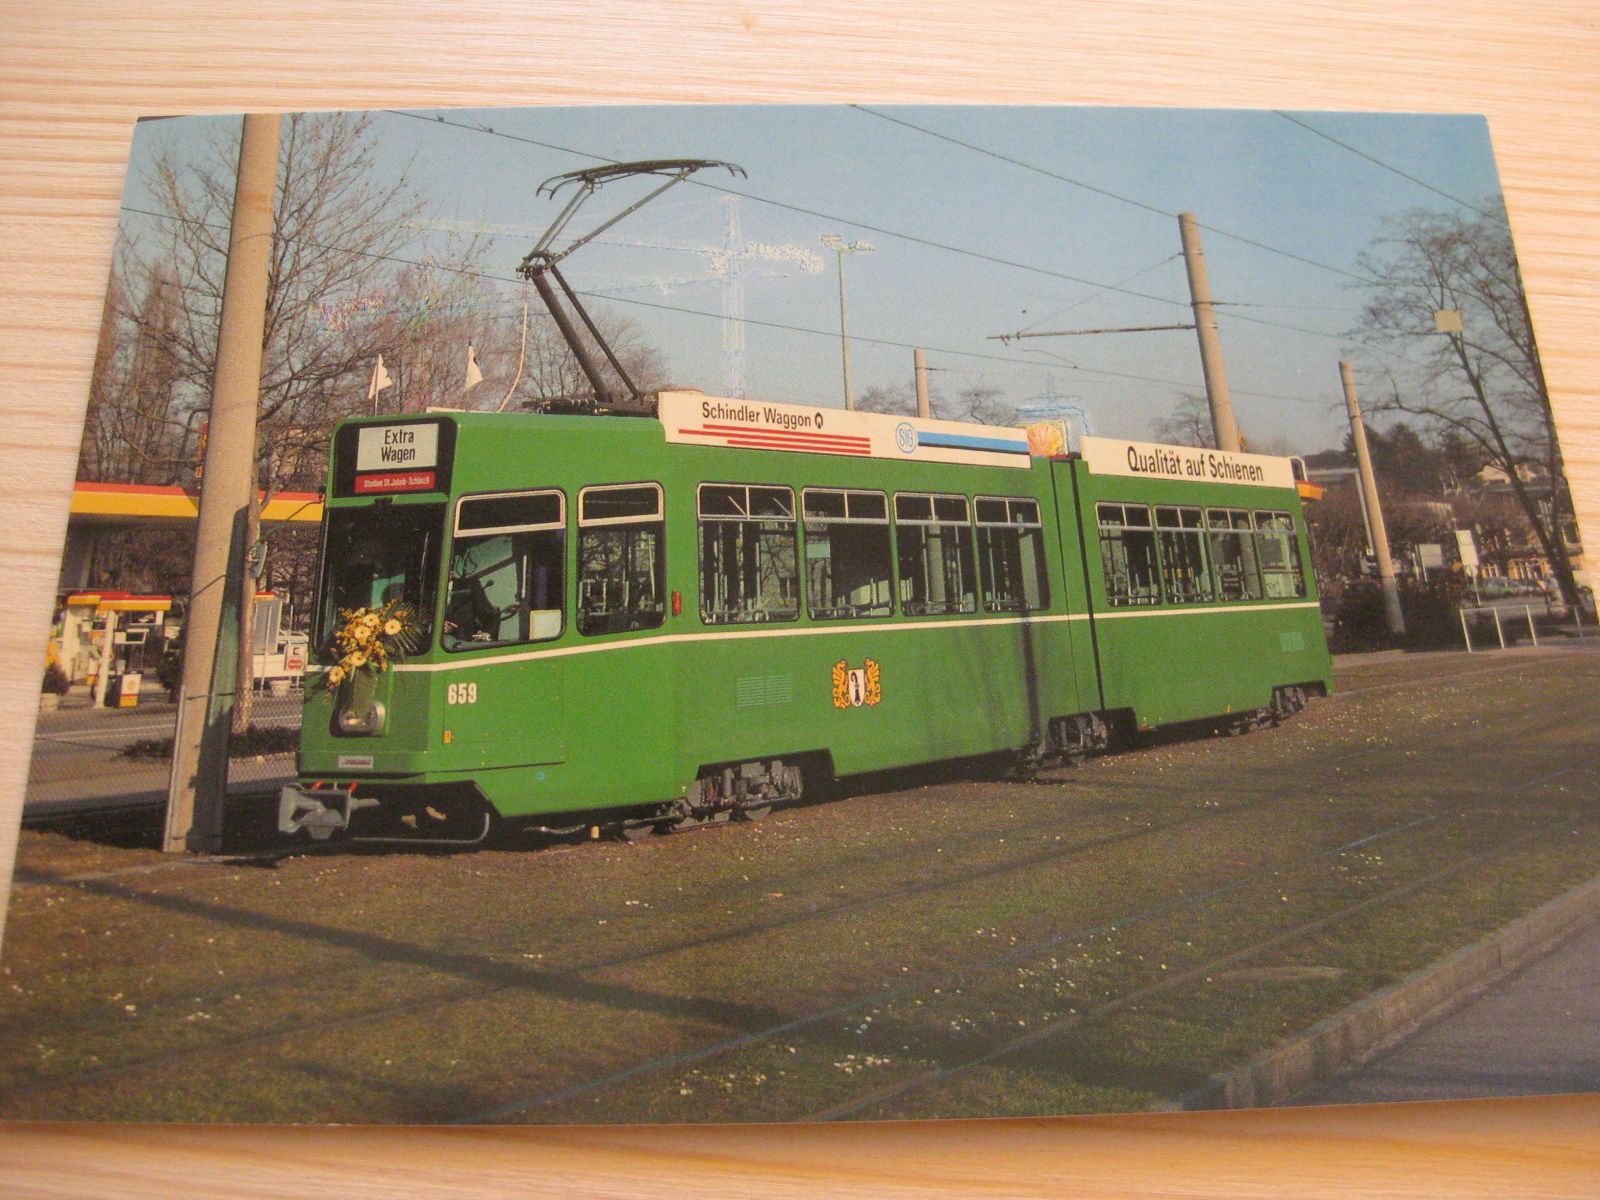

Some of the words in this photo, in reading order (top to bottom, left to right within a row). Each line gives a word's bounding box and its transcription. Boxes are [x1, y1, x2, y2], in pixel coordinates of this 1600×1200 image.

[702, 402, 760, 423] Schindler
[764, 408, 811, 430] Waggon
[385, 429, 415, 445] Extra
[899, 428, 914, 448] SIG
[381, 447, 416, 463] Wagen
[1127, 446, 1182, 476] Qualität
[1186, 454, 1206, 477] auf
[1208, 454, 1264, 482] Schienen
[447, 682, 477, 705] 659
